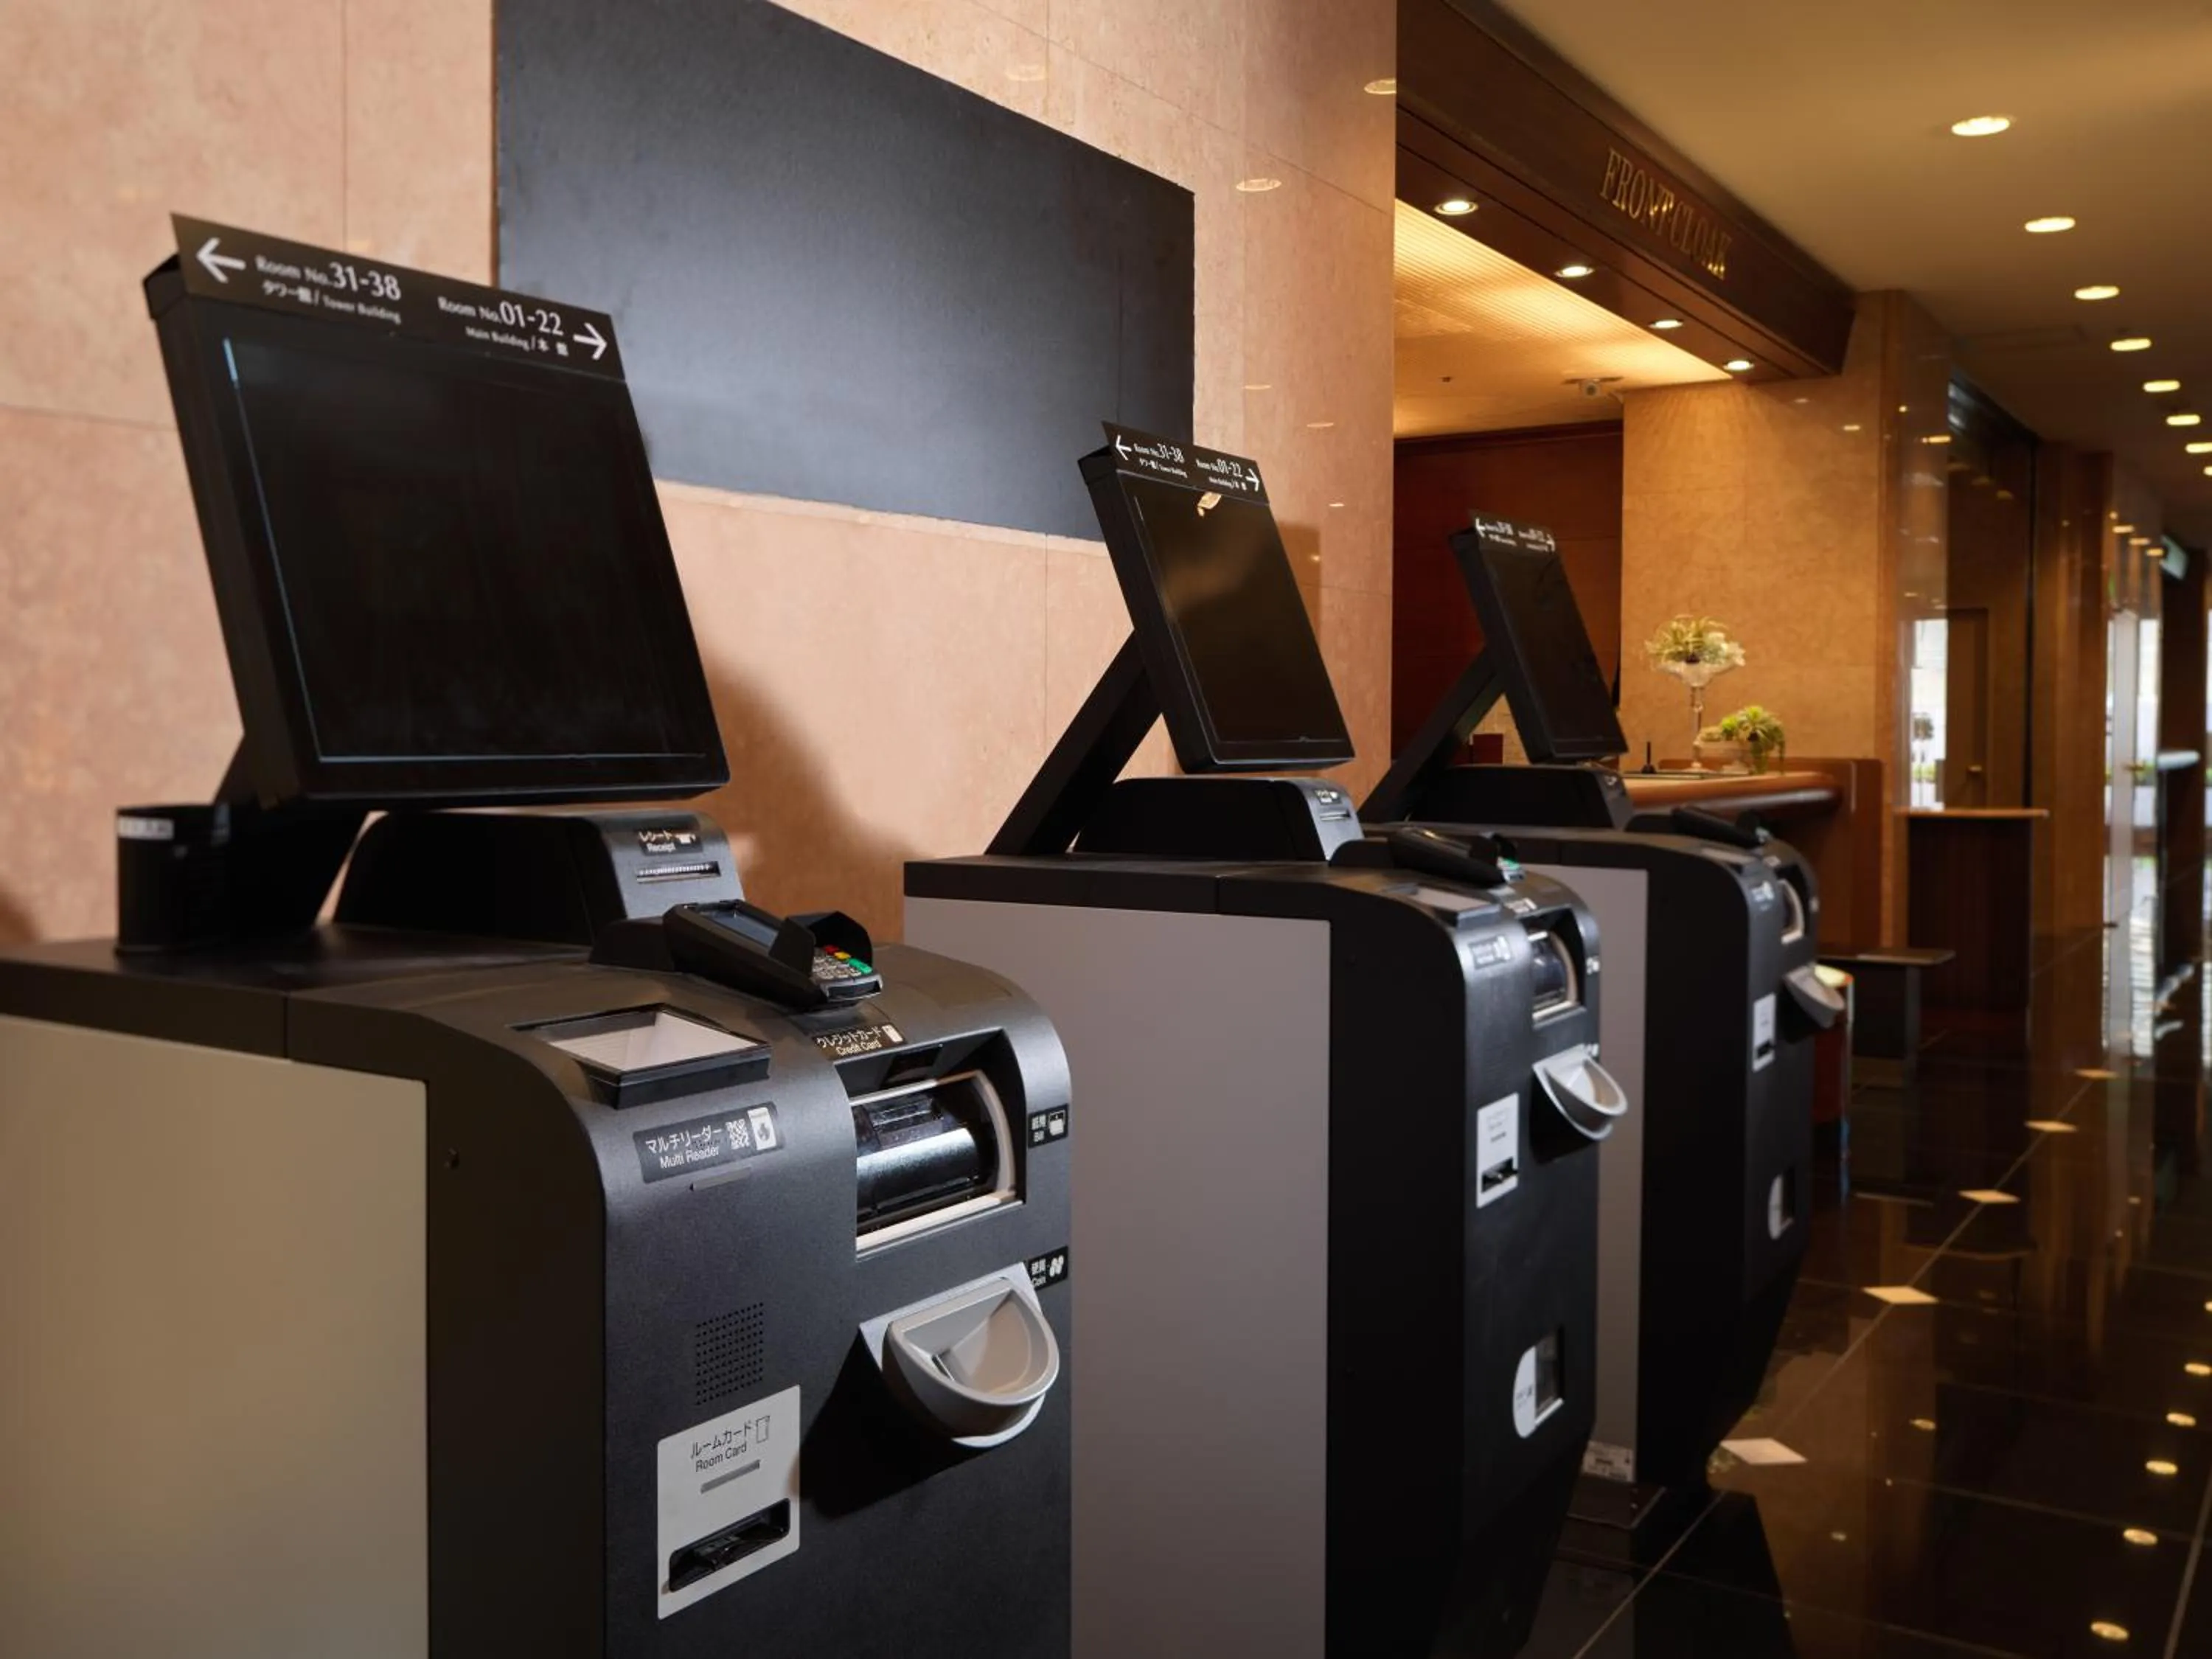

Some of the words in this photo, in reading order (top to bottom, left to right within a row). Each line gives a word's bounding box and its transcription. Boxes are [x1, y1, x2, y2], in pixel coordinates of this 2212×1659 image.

[255, 255, 301, 279] Room
[437, 296, 476, 317] Room
[645, 1124, 723, 1154] マルチリーダー
[659, 1154, 684, 1169] Multi
[686, 1144, 720, 1163] Reader
[690, 1419, 752, 1460] ルームカード
[695, 1452, 723, 1472] Room
[725, 1441, 747, 1460] Card
